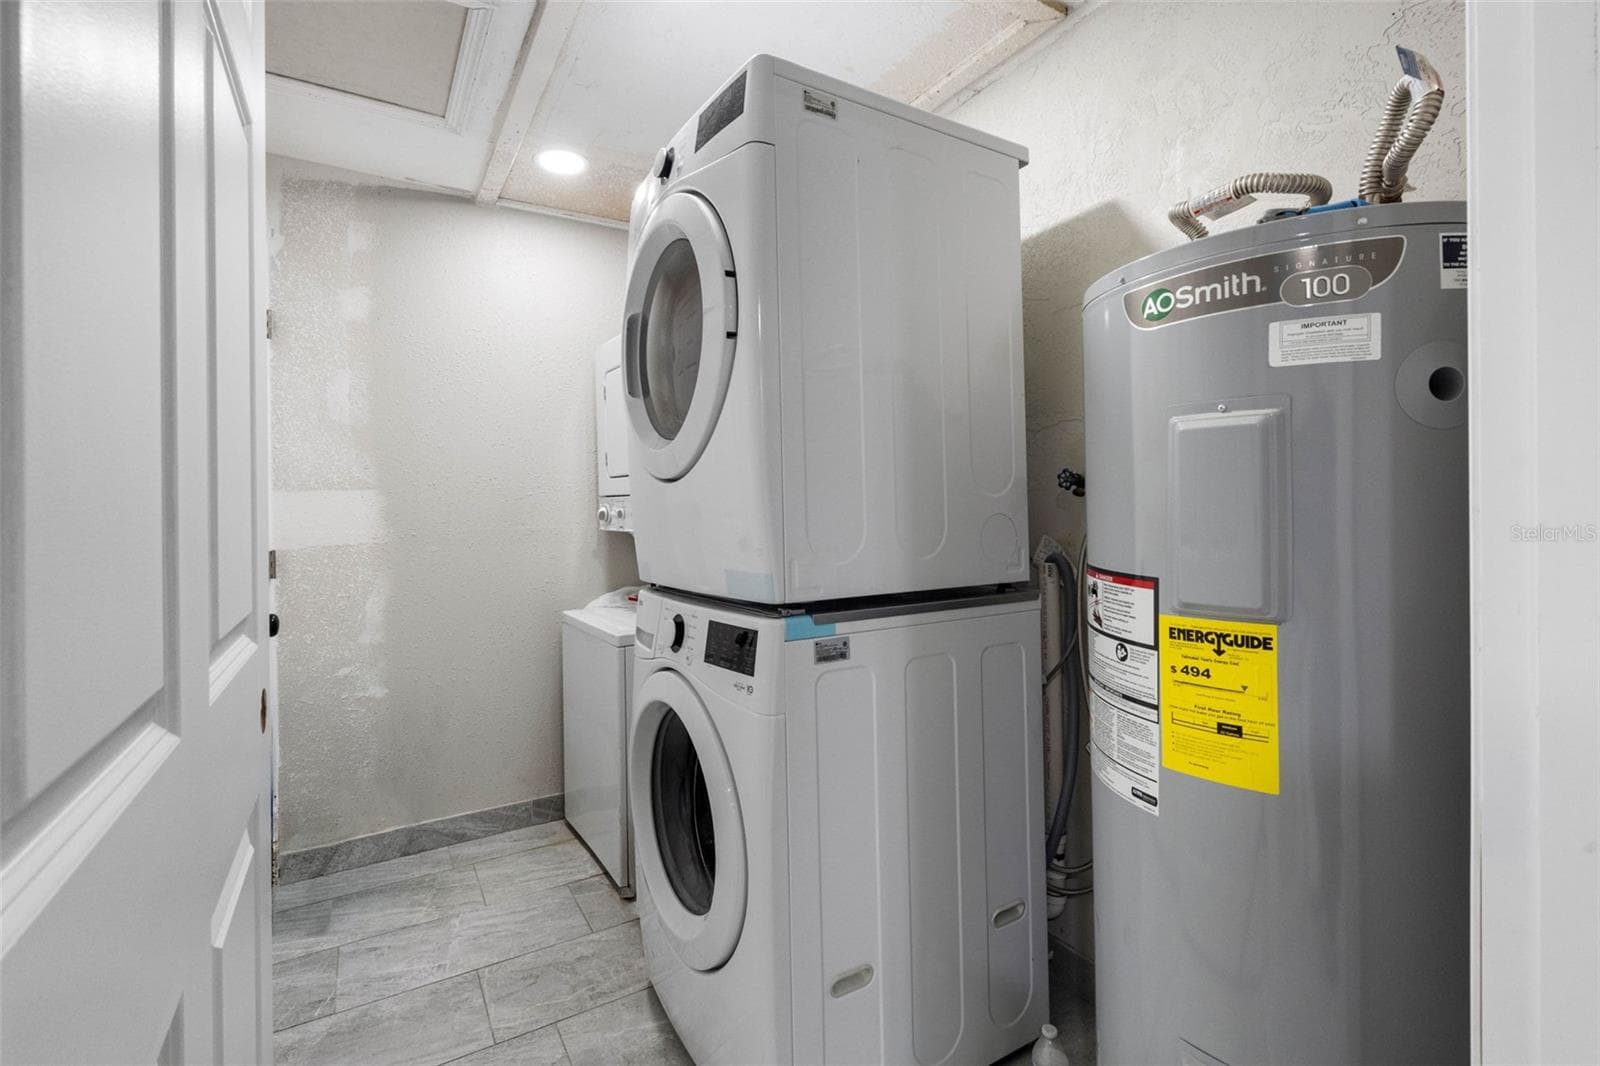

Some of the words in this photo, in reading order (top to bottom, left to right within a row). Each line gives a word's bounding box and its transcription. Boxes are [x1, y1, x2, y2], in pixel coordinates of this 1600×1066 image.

[1273, 251, 1377, 273] SIGNATURE
[1301, 273, 1350, 299] 100
[1300, 319, 1348, 330] IMPORTANT
[1168, 626, 1274, 652] ENERGYGUIDE
[1180, 664, 1212, 680] 494
